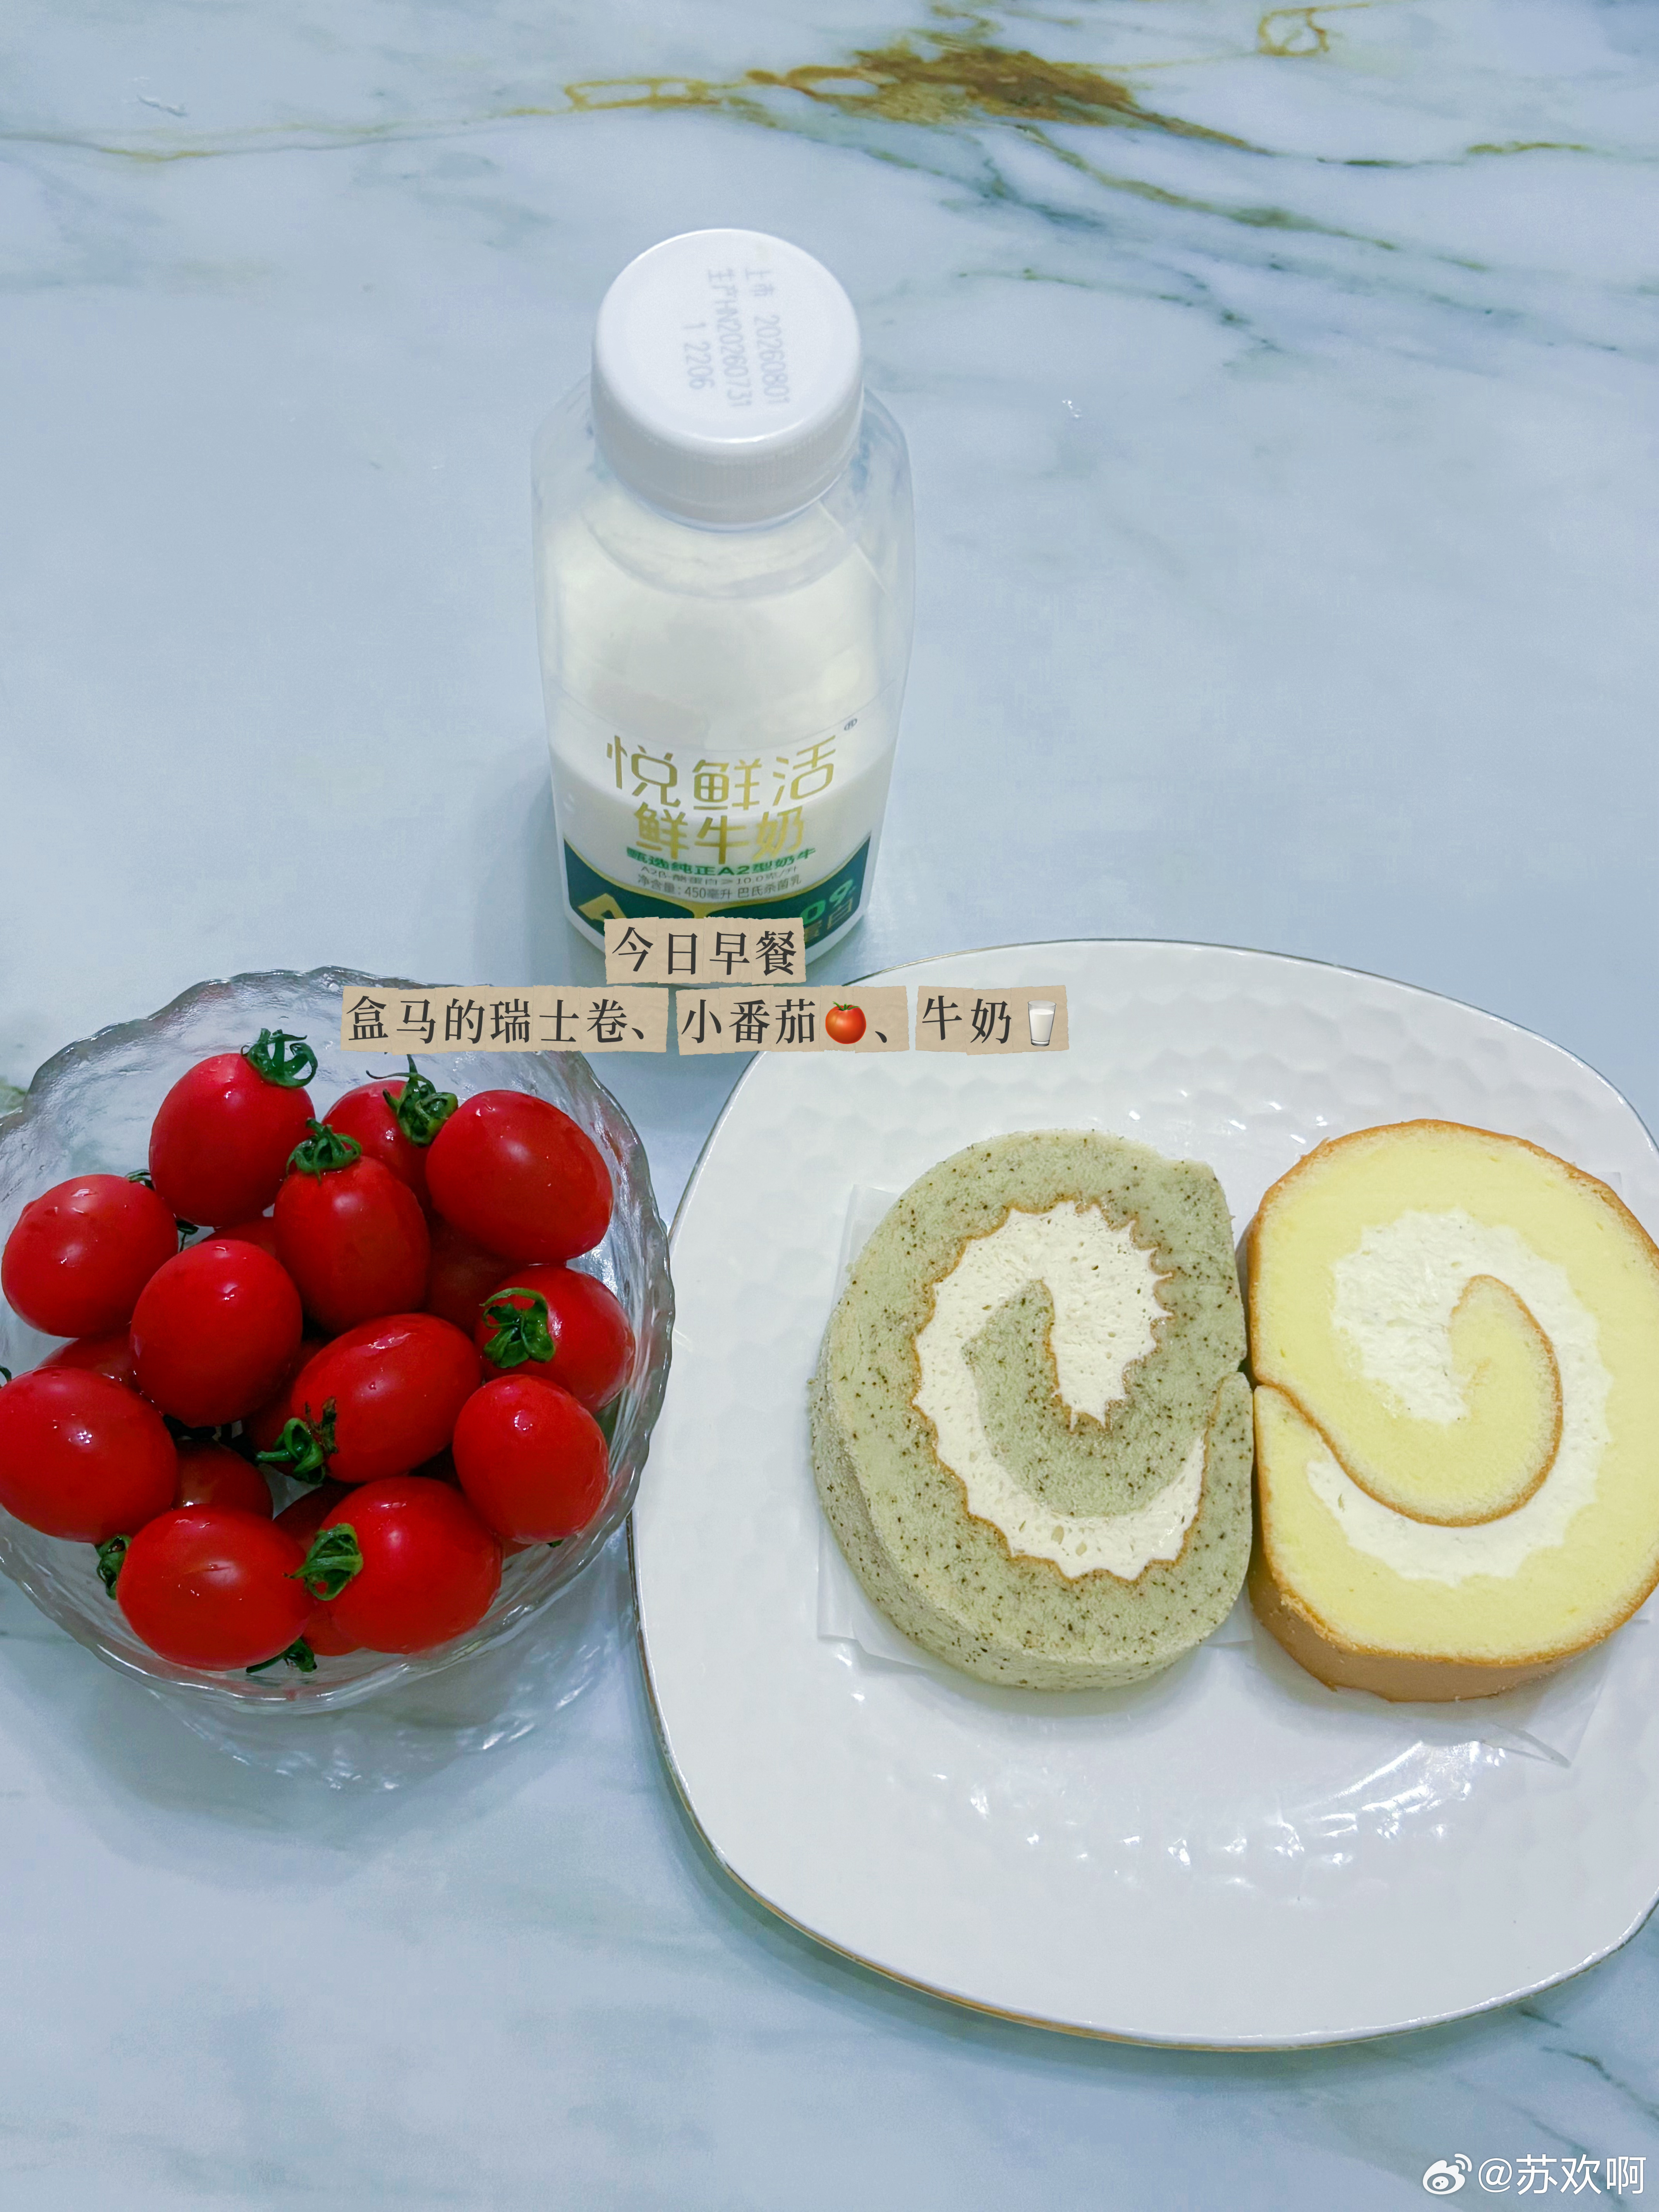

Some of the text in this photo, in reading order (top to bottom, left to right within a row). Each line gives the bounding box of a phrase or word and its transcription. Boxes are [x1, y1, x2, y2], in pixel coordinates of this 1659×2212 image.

[684, 341, 715, 390] 2206
[744, 268, 790, 405] 上市 20260801
[606, 734, 836, 811] 悦鲜活
[634, 802, 805, 864] 鲜牛奶
